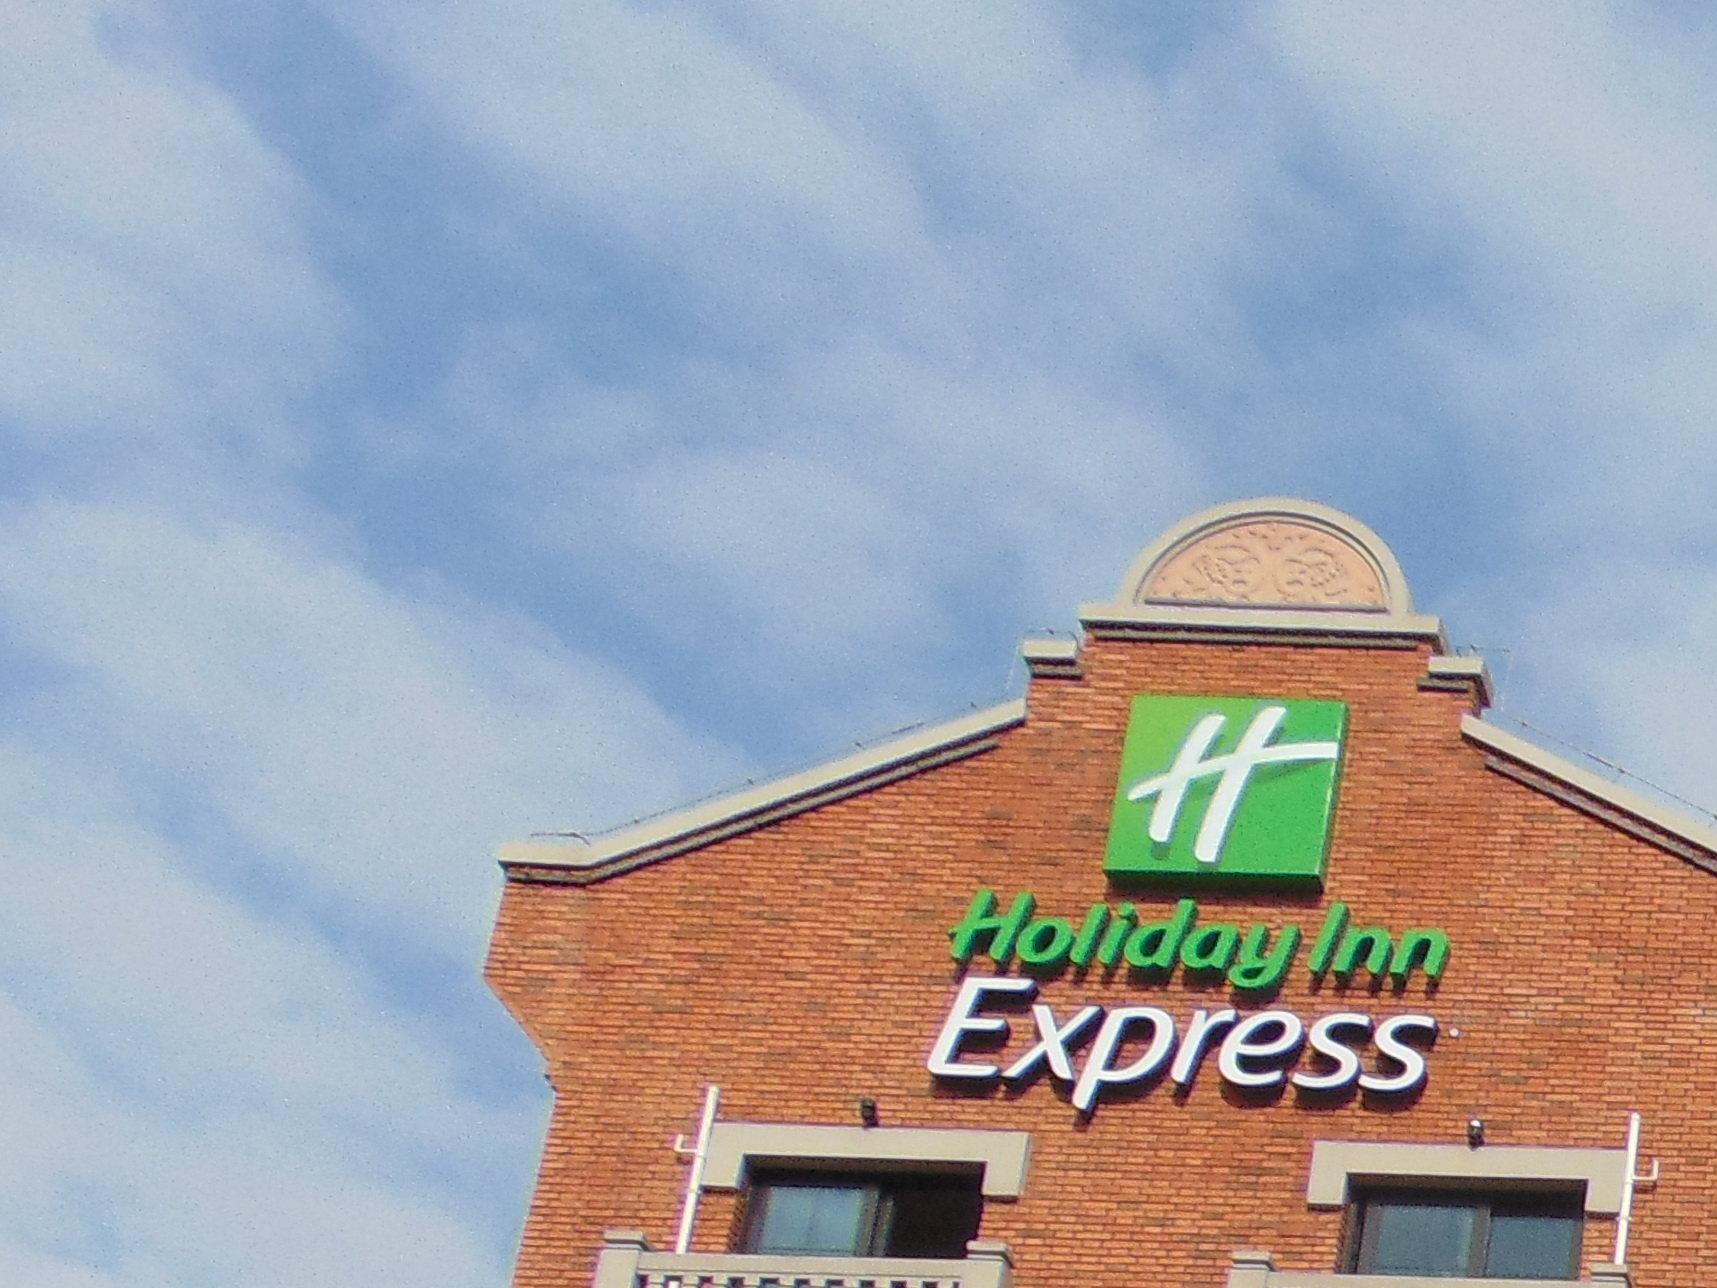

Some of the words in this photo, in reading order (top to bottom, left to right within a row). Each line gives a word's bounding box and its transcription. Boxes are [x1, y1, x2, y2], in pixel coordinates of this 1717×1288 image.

[948, 888, 1300, 990] Holiday
[1308, 901, 1450, 979] Inn
[927, 976, 1438, 1112] Express
